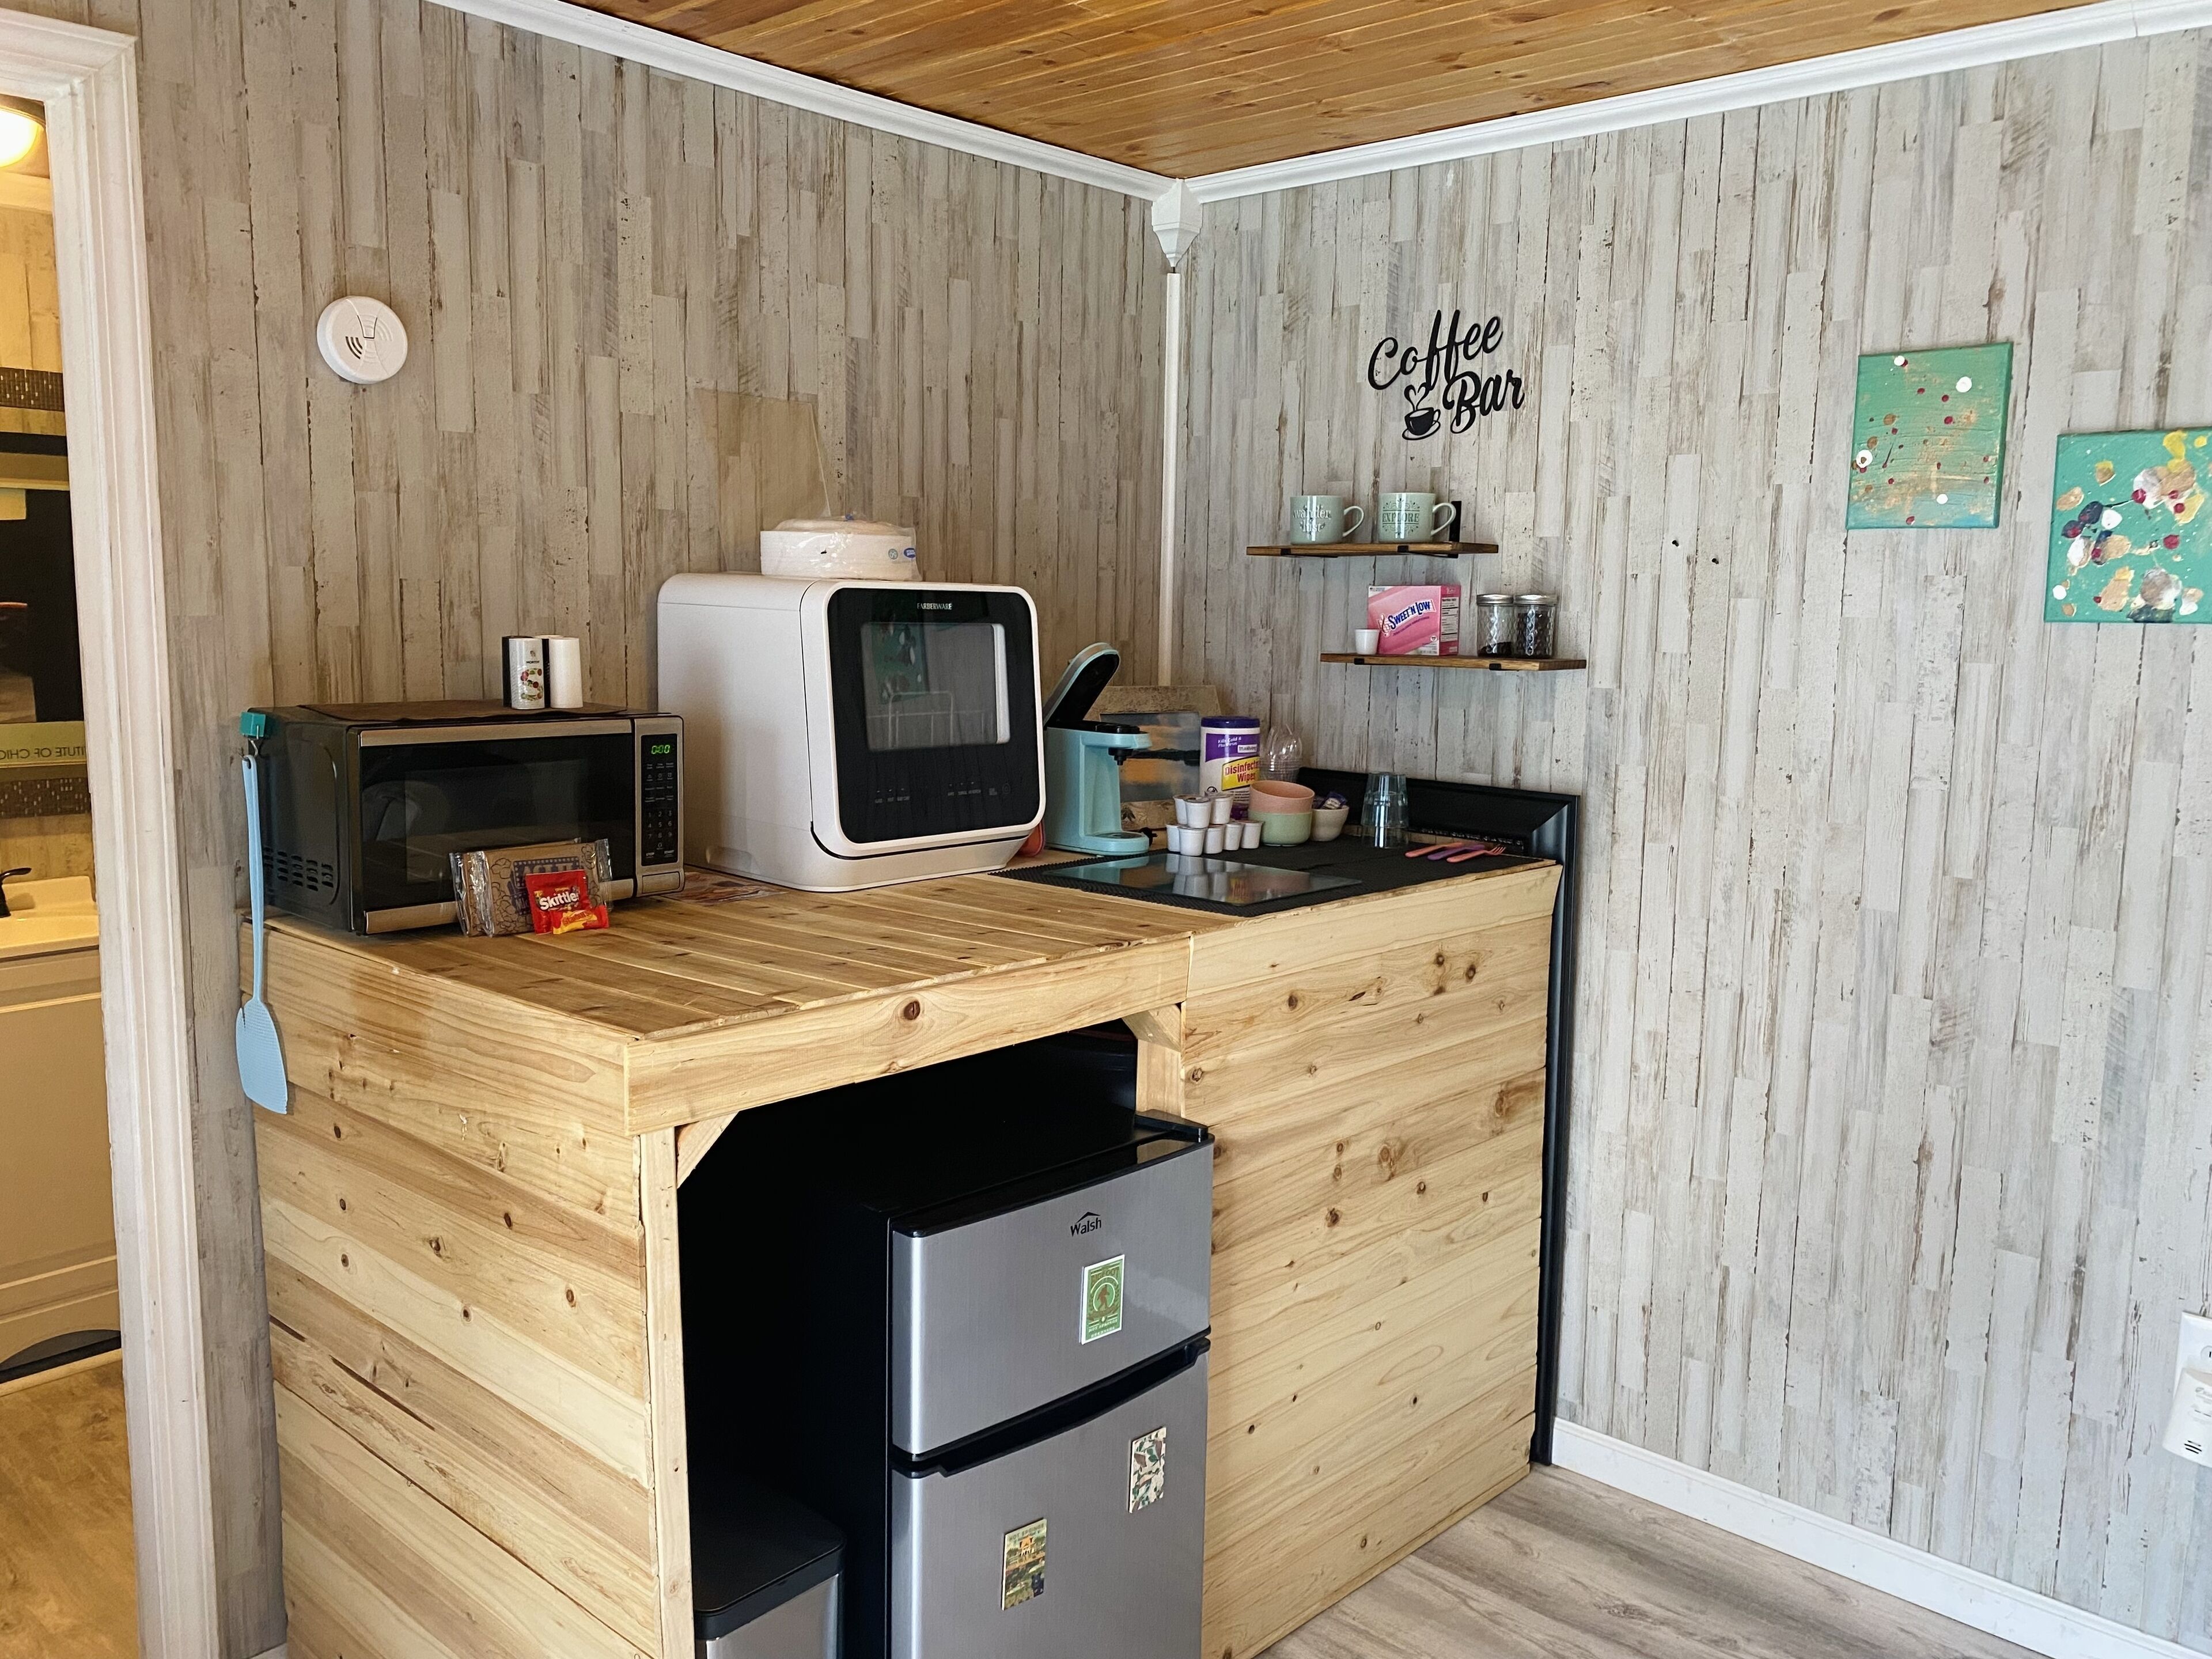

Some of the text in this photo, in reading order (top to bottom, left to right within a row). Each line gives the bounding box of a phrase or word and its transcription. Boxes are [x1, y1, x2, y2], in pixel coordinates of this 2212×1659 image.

[1368, 309, 1503, 391] Coffee
[1442, 369, 1525, 434] Bar
[1070, 1217, 1102, 1237] Walsh
